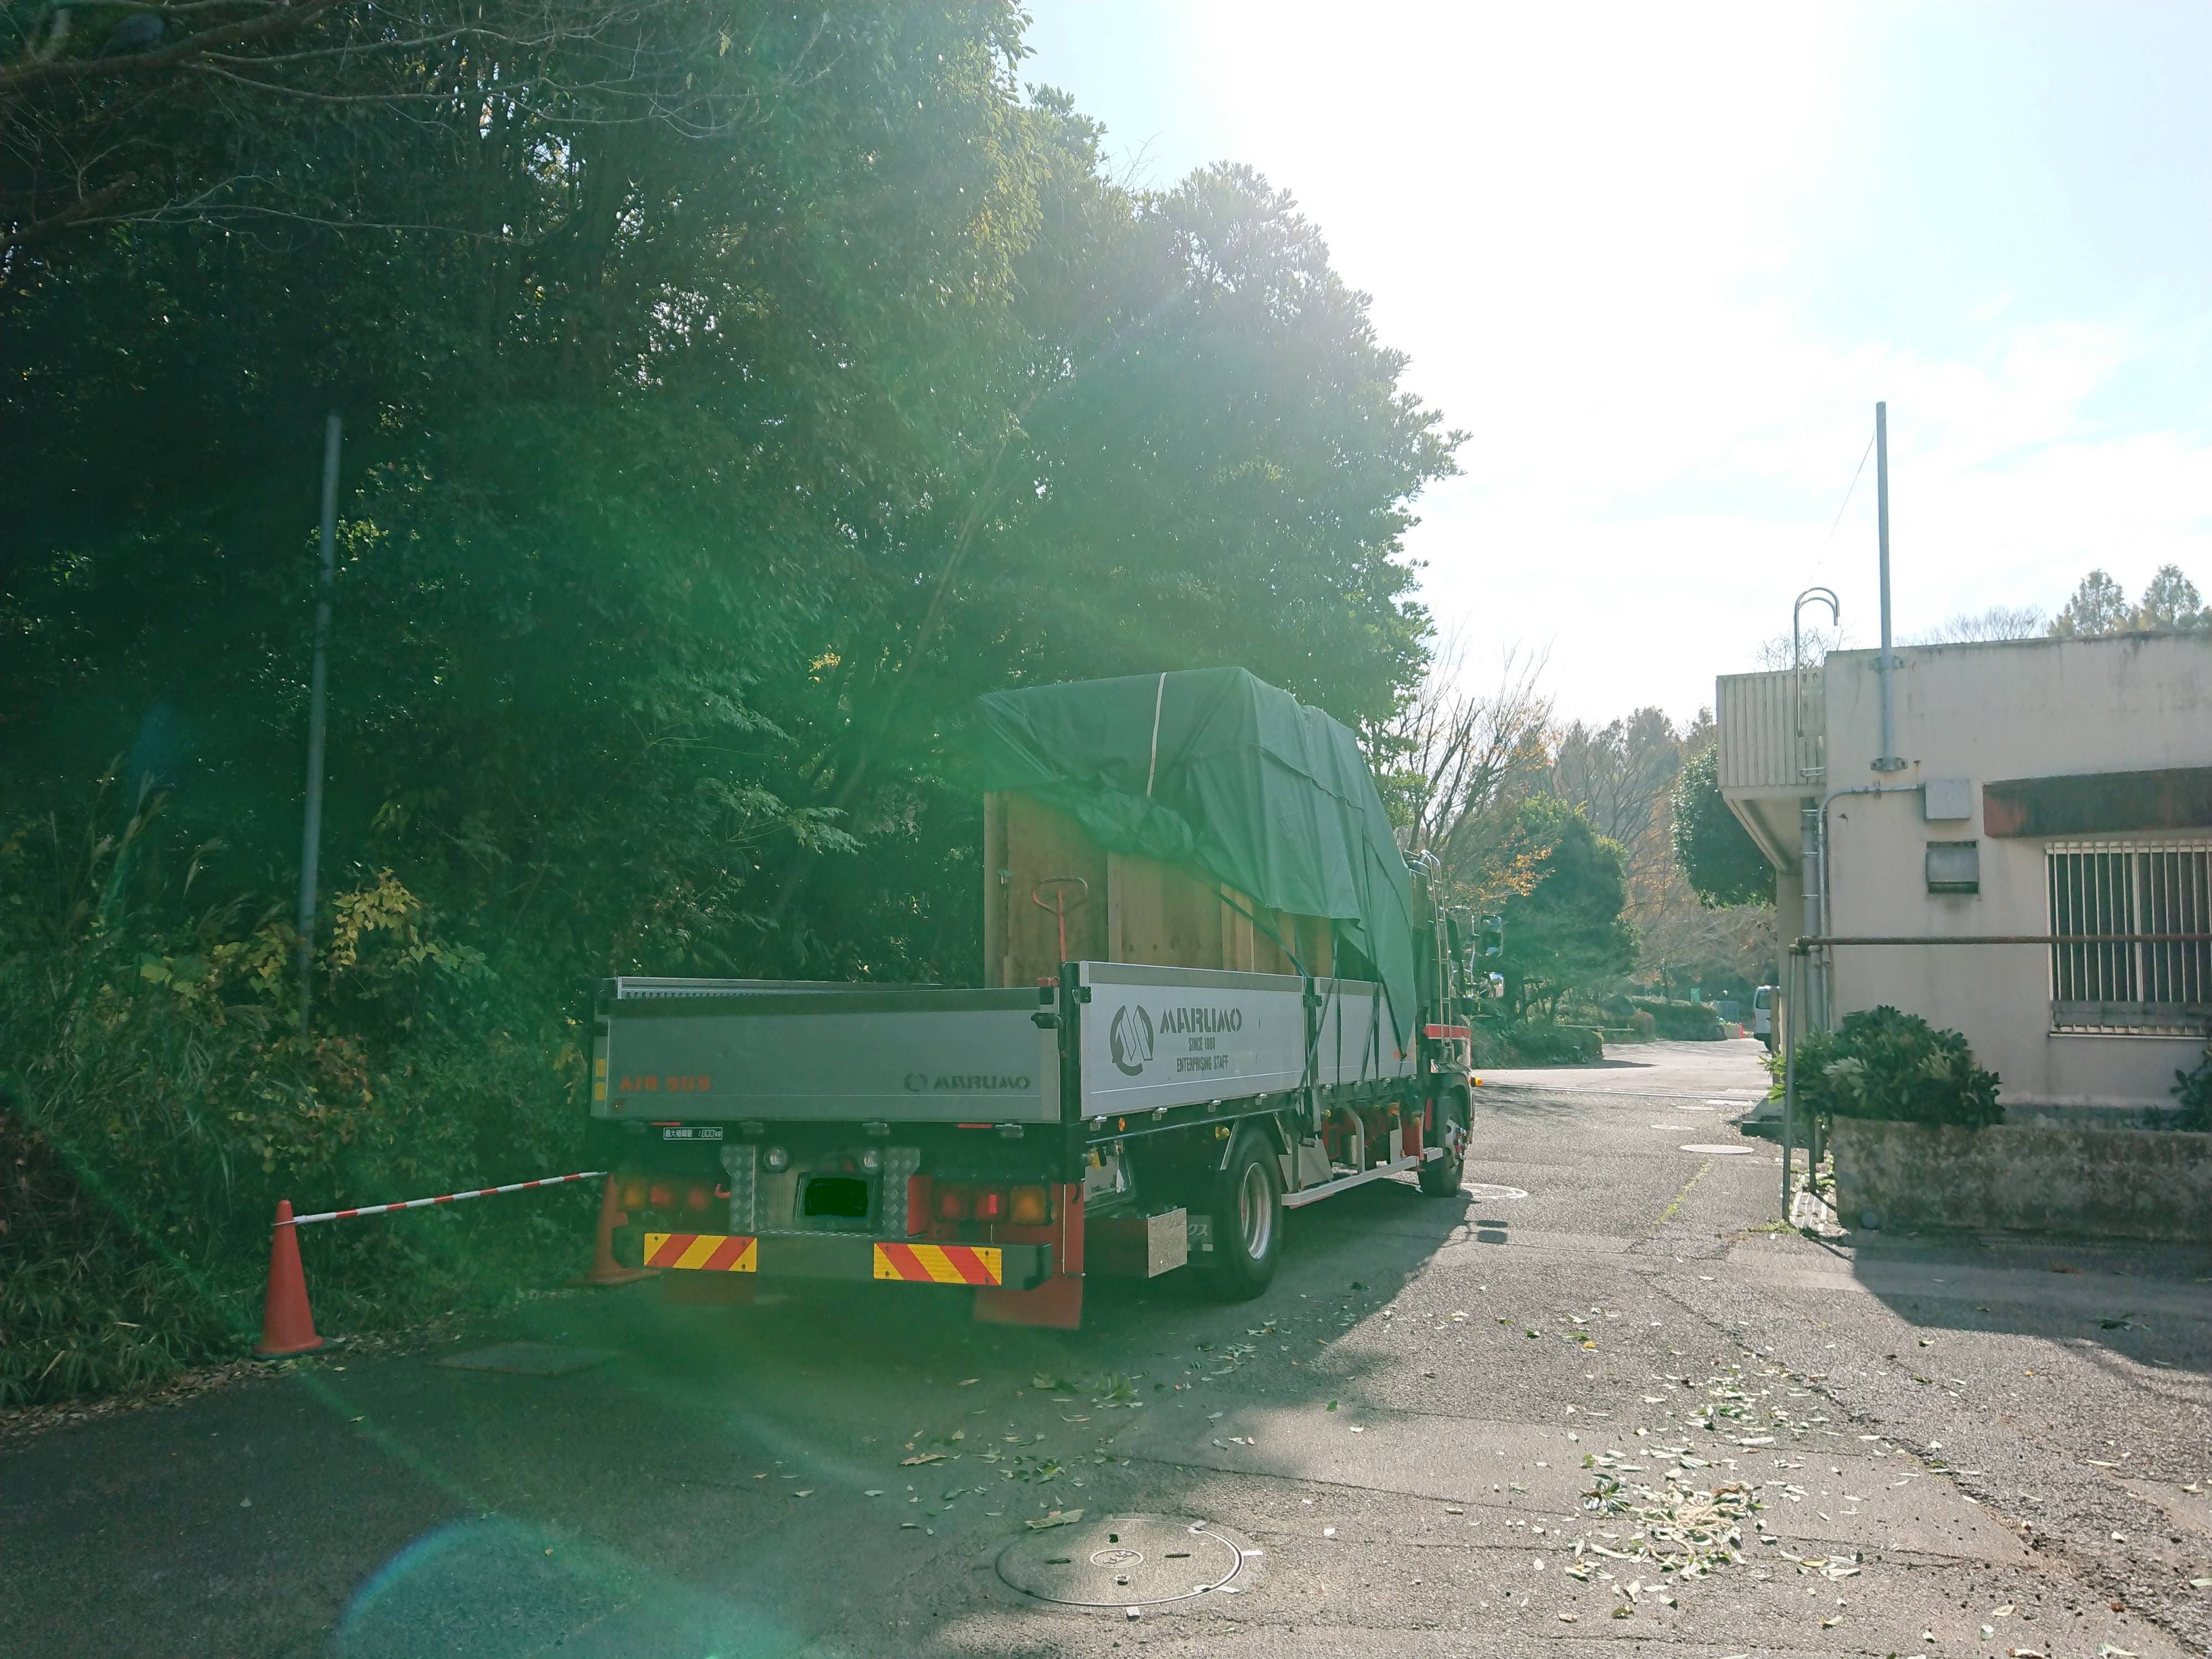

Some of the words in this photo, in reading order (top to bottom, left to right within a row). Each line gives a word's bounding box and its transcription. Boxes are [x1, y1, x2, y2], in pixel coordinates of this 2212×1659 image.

[1160, 1008, 1242, 1034] MARUMO
[1188, 1037, 1203, 1051] SINCE
[1177, 1056, 1212, 1072] ENTERPRISING
[1214, 1055, 1228, 1070] STAFF
[619, 1076, 657, 1092] AIR
[933, 1075, 1031, 1089] MARUMO
